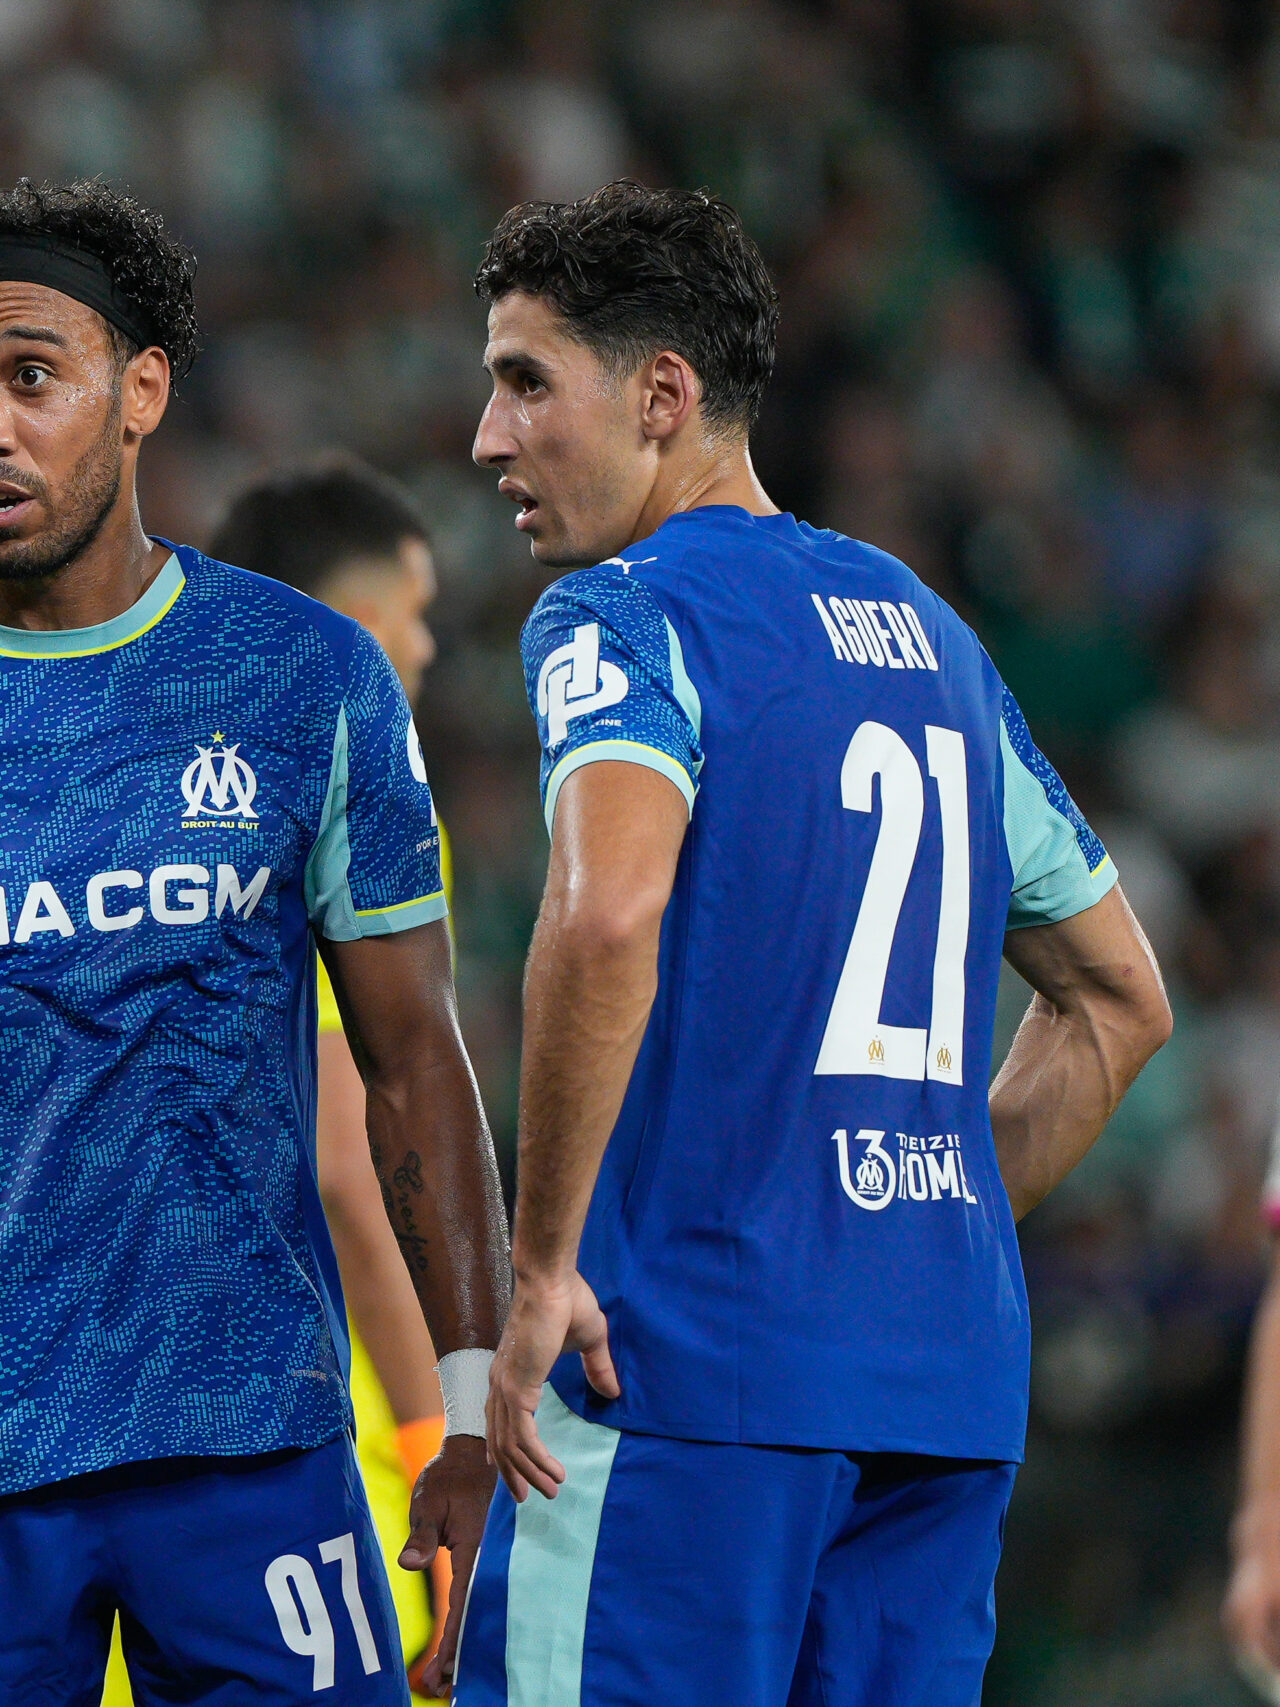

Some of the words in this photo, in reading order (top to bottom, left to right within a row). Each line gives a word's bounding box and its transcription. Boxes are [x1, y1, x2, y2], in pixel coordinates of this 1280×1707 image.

[810, 593, 939, 671] AGUERO
[181, 821, 217, 829] DROIT
[220, 821, 235, 829] AU
[238, 821, 260, 831] BUT
[86, 863, 271, 932] CGM
[813, 720, 970, 1087] 21
[830, 1129, 897, 1211] 13
[264, 1532, 381, 1691] 97
